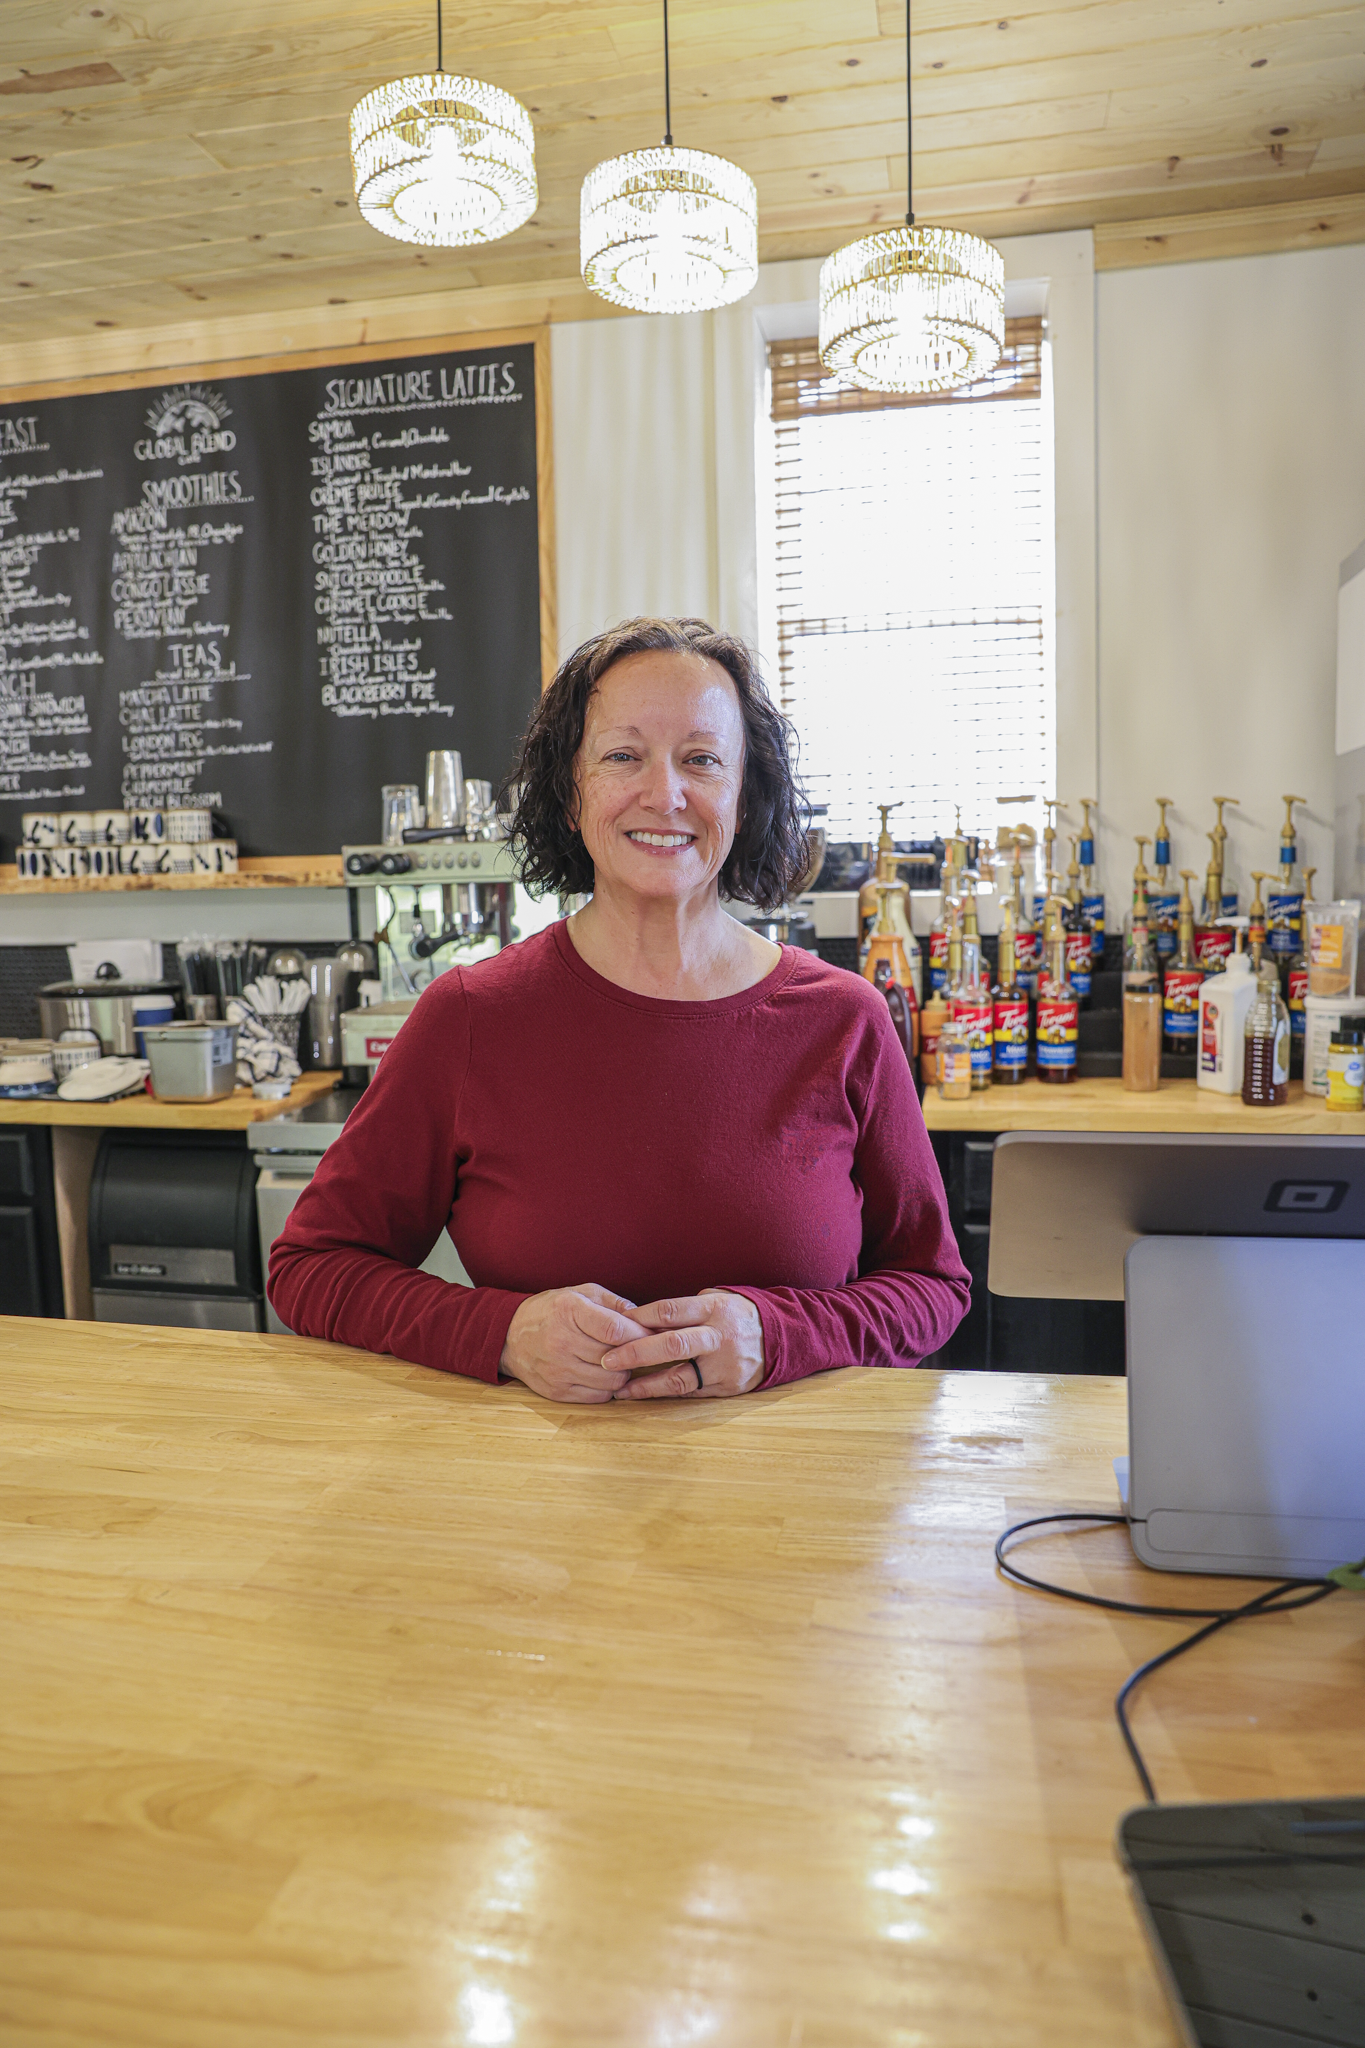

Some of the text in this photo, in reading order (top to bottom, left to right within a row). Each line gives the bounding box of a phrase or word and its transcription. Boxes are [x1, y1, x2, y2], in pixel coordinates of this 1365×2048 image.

[324, 362, 515, 413] SIGNATURE LATTES
[308, 420, 355, 443] SAMOA
[133, 430, 236, 461] GLOBAL BLEND
[310, 452, 371, 476] ISLANDER
[140, 470, 242, 508] SMOOTHIES
[312, 508, 410, 534] THE MEADOW
[312, 539, 410, 564] GOLDEN HONEY
[110, 578, 163, 602] CONGO
[313, 565, 425, 591] SNICKERDOODLE
[314, 592, 430, 616] CARAMEL COOKIE
[316, 624, 382, 645] NUTELLA
[168, 640, 222, 669] TEAS
[318, 652, 418, 676] IRISH ISLES
[172, 684, 214, 704] LATTE
[320, 682, 436, 706] BLACKBERRY PIE
[119, 706, 156, 726] CHAI
[158, 703, 203, 724] LATTE
[121, 732, 176, 752] LONDON
[178, 730, 204, 749] FOG
[1038, 1006, 1076, 1031] Torani
